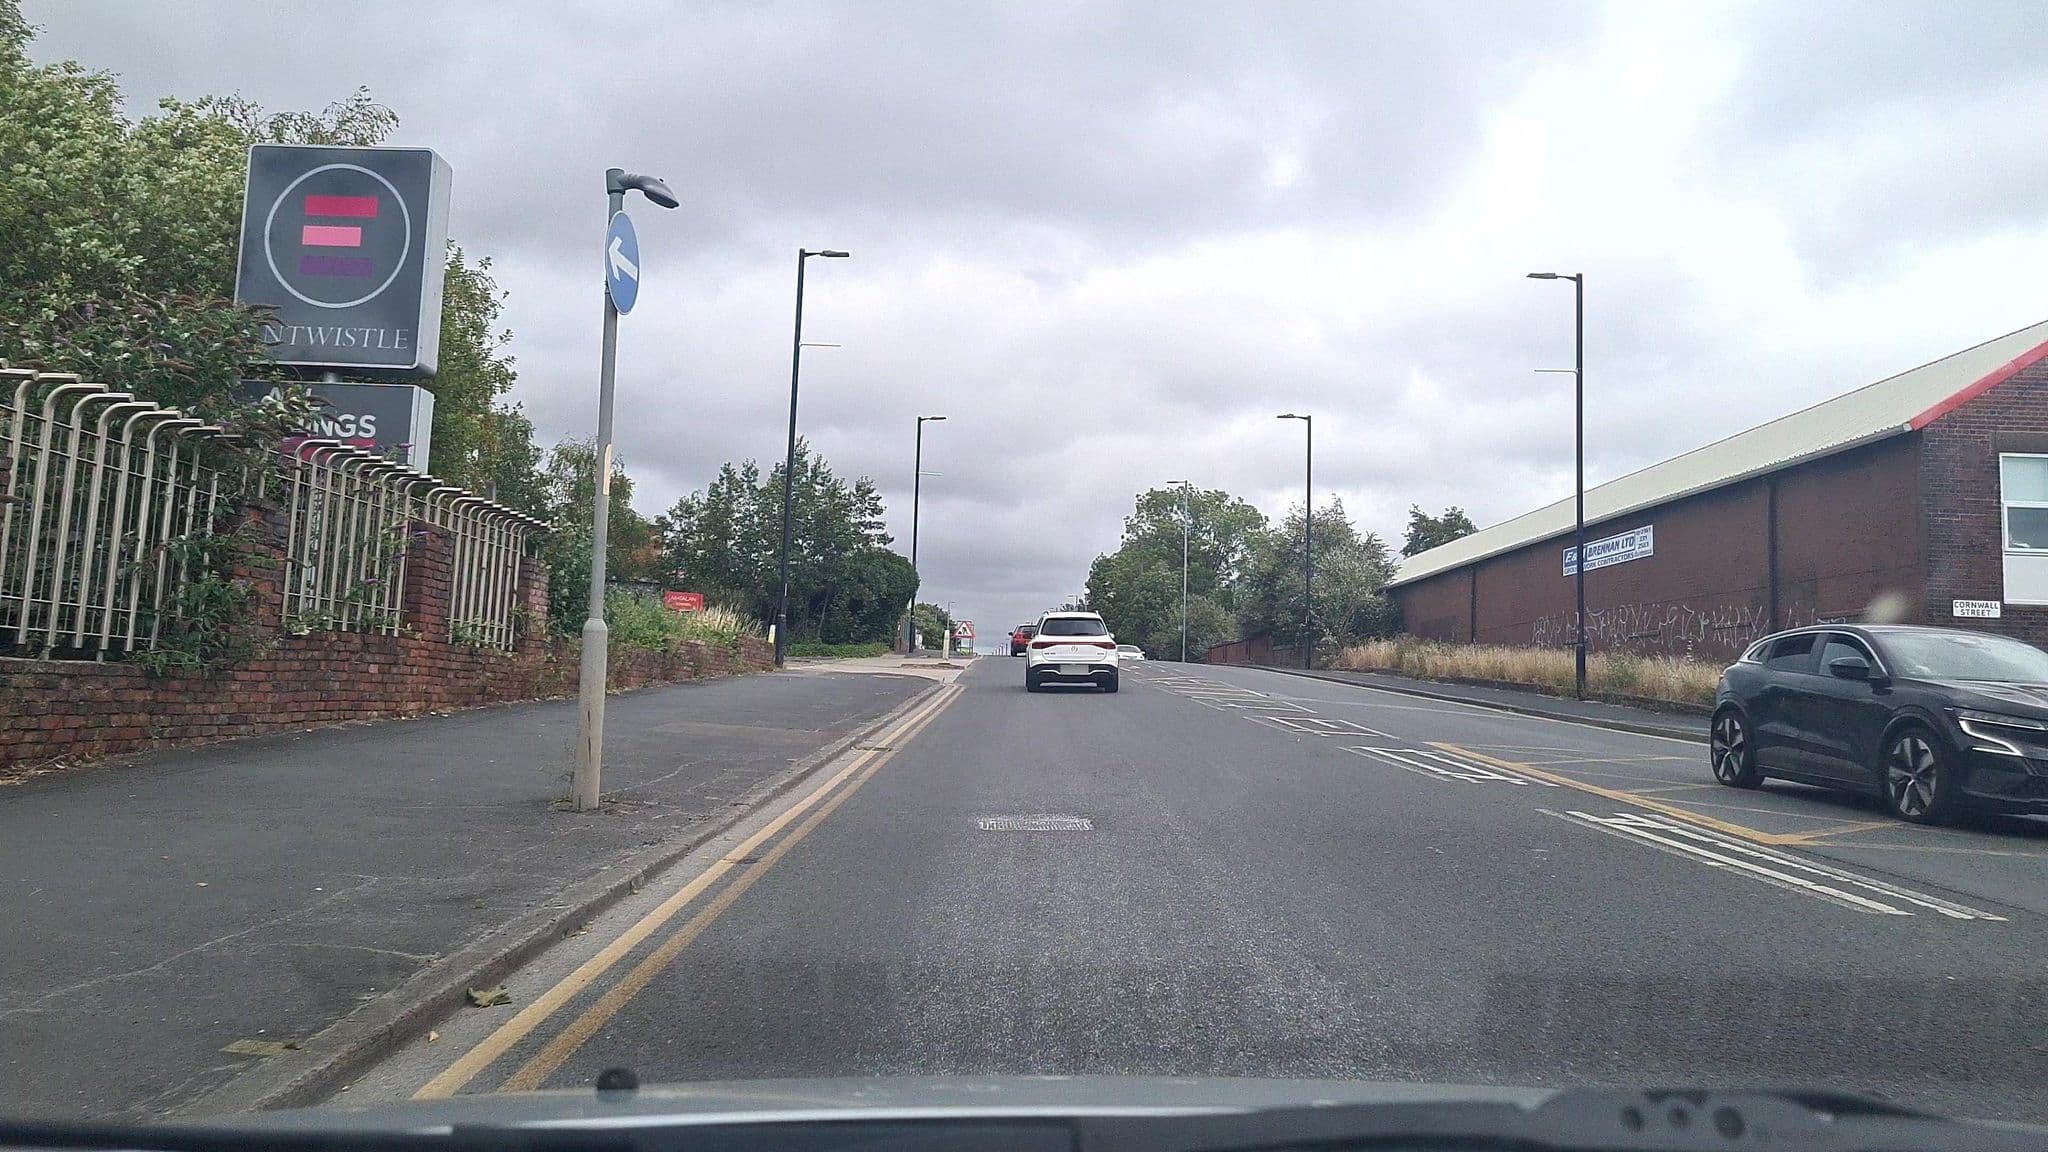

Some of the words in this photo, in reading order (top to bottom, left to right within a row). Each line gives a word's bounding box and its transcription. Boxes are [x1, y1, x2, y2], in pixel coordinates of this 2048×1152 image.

[258, 324, 409, 349] NTWISTLE
[1588, 540, 1620, 558] BRENNAN
[1621, 536, 1635, 549] LTD
[1597, 552, 1634, 566] CONTRACTORS
[1954, 601, 1999, 609] CORNWALL
